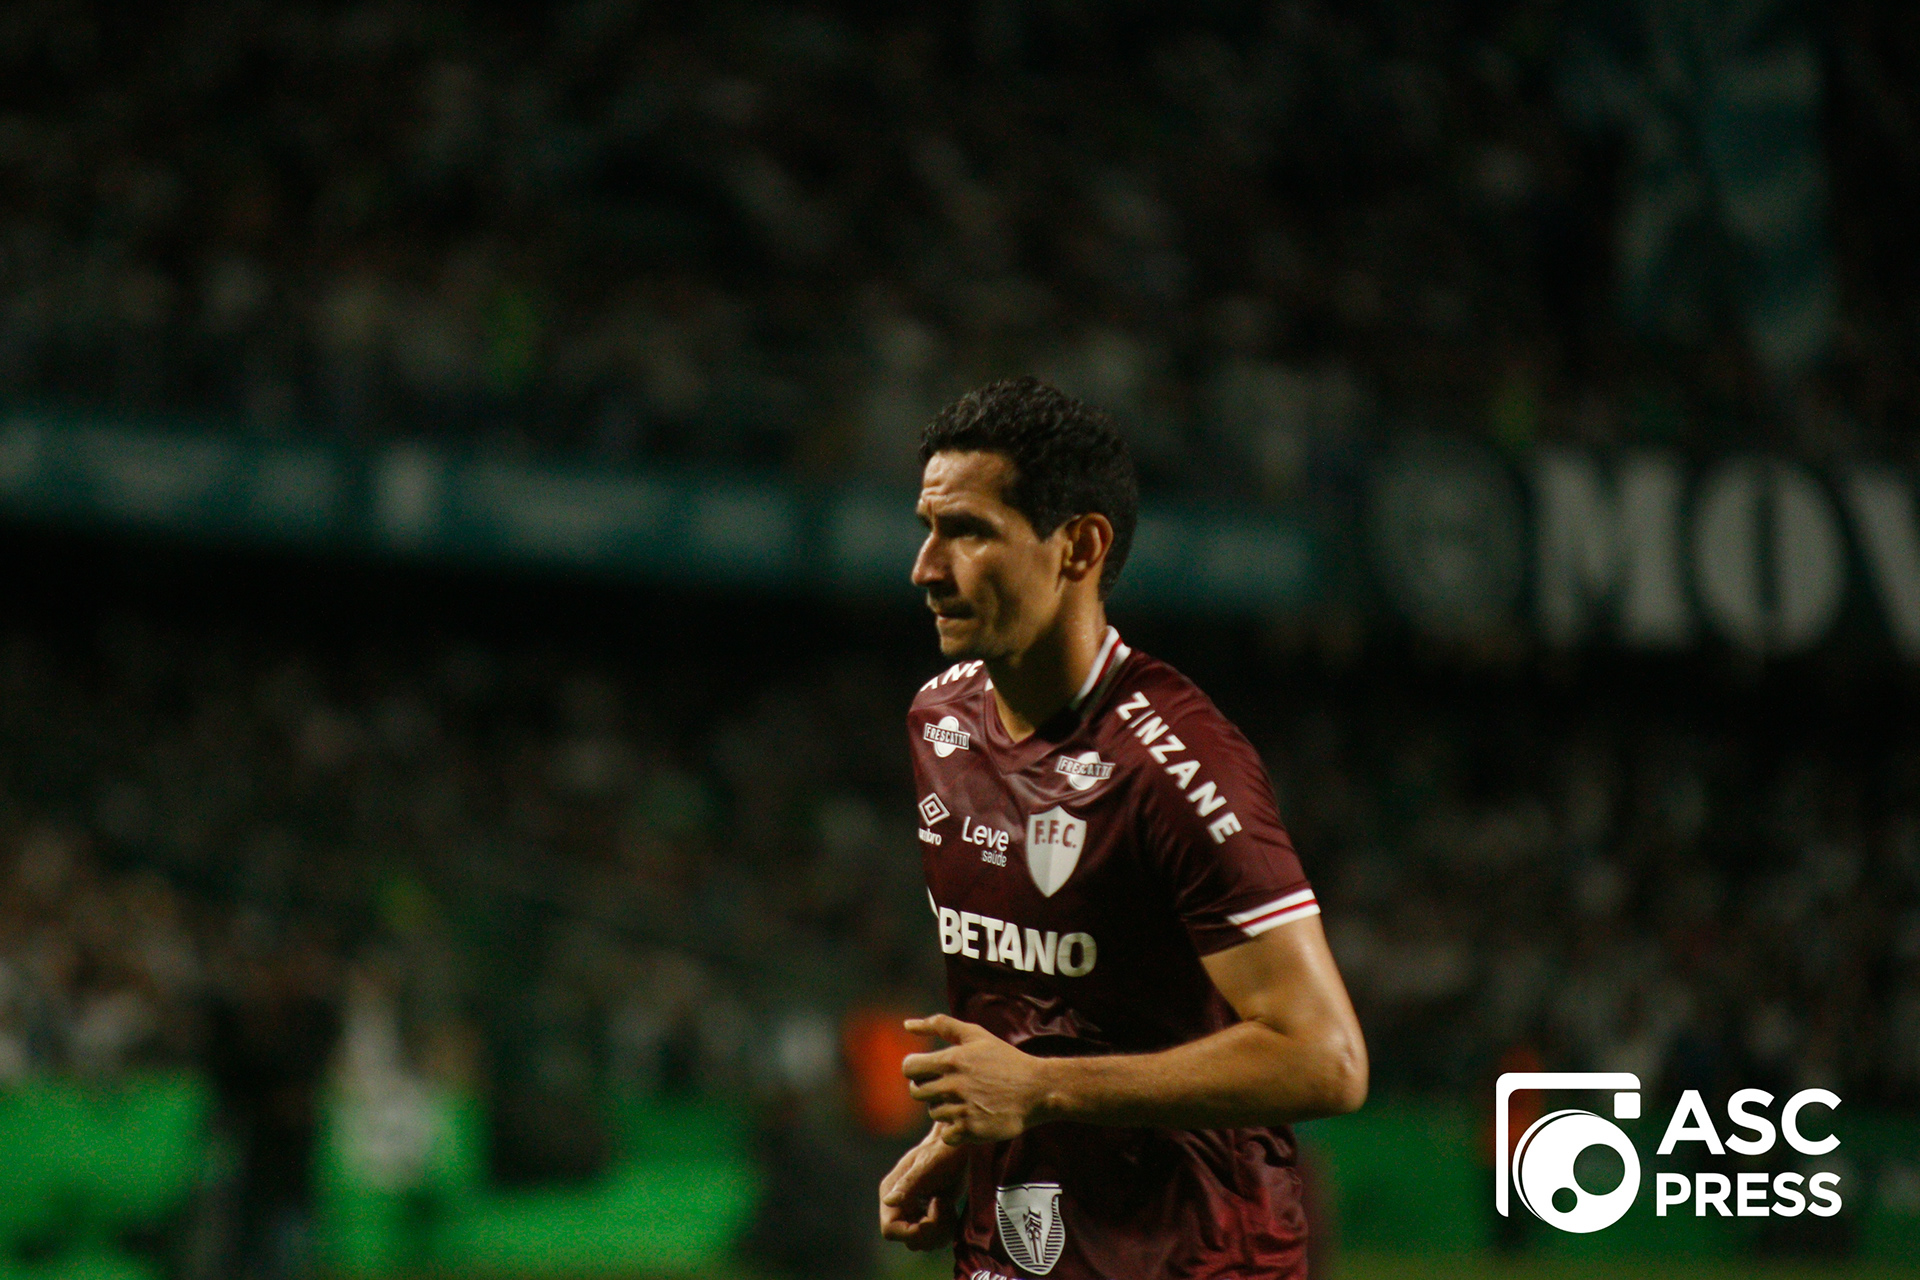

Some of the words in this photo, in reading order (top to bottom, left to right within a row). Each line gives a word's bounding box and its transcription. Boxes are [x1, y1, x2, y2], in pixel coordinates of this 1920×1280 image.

[926, 726, 967, 747] FRESCATTO
[1115, 691, 1243, 844] ZINZANE
[961, 815, 1010, 852] Leve
[1034, 819, 1077, 849] F.F.C.
[981, 850, 1008, 868] saúde
[938, 905, 1098, 979] BETANO
